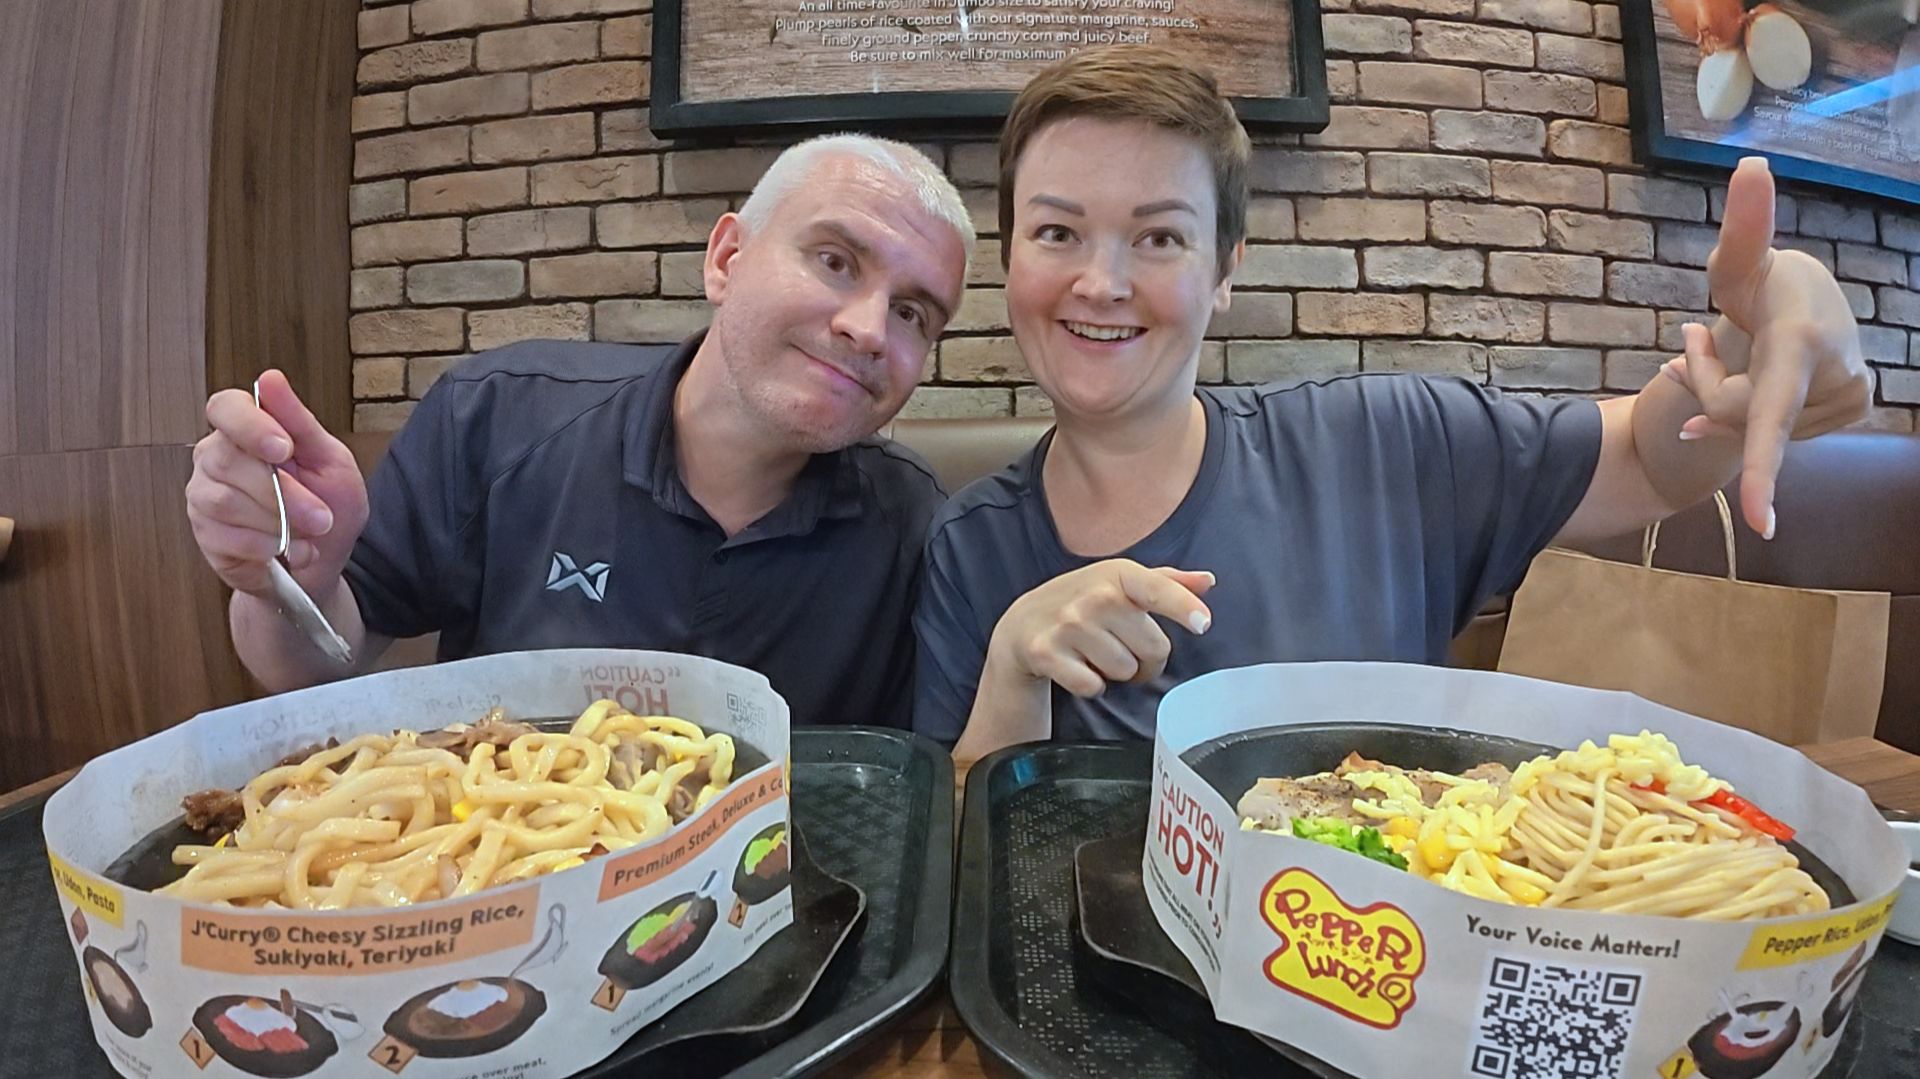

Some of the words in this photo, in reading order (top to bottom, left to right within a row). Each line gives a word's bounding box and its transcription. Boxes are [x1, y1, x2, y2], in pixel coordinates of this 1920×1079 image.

[819, 0, 833, 12] all
[1092, 0, 1120, 10] your
[1124, 0, 1176, 13] craving!
[775, 17, 815, 33] Plump
[818, 16, 858, 32] pearls
[860, 15, 876, 28] of
[879, 14, 904, 27] rice
[906, 13, 952, 26] coated
[956, 13, 986, 25] with
[990, 15, 1013, 25] our
[1015, 13, 1077, 29] signature
[1081, 14, 1149, 28] margarine,
[1151, 16, 1199, 30] sauces,
[862, 32, 910, 47] ground
[913, 31, 963, 45] pepper,
[966, 29, 1020, 44] crunchy
[1022, 32, 1053, 43] corn
[1056, 30, 1080, 42] and
[1084, 31, 1116, 45] juicy
[1119, 31, 1153, 45] beef.
[850, 50, 868, 63] Be
[870, 52, 899, 63] sure
[901, 50, 916, 61] to
[919, 48, 945, 61] mix
[949, 48, 976, 61] well
[977, 47, 1000, 60] for
[1003, 48, 1066, 60] maximum
[613, 845, 686, 886] Premium
[722, 792, 756, 823] Deluxe
[757, 784, 767, 797] &
[86, 886, 115, 914] Pasta
[287, 926, 367, 948] Cheesy
[372, 917, 464, 943] Sizzling
[470, 903, 525, 927] Rice,
[1466, 914, 1517, 941] Your
[1525, 926, 1584, 951] Voice
[1590, 933, 1681, 959] Matters!
[1763, 934, 1822, 957] Pepper
[254, 948, 354, 969] Sukiyaki,
[360, 937, 456, 964] Teriyaki
[607, 983, 615, 1004] 1
[192, 1039, 201, 1059] 1
[383, 1045, 402, 1066] 2
[482, 1067, 509, 1078] over
[1672, 1057, 1685, 1079] 1
